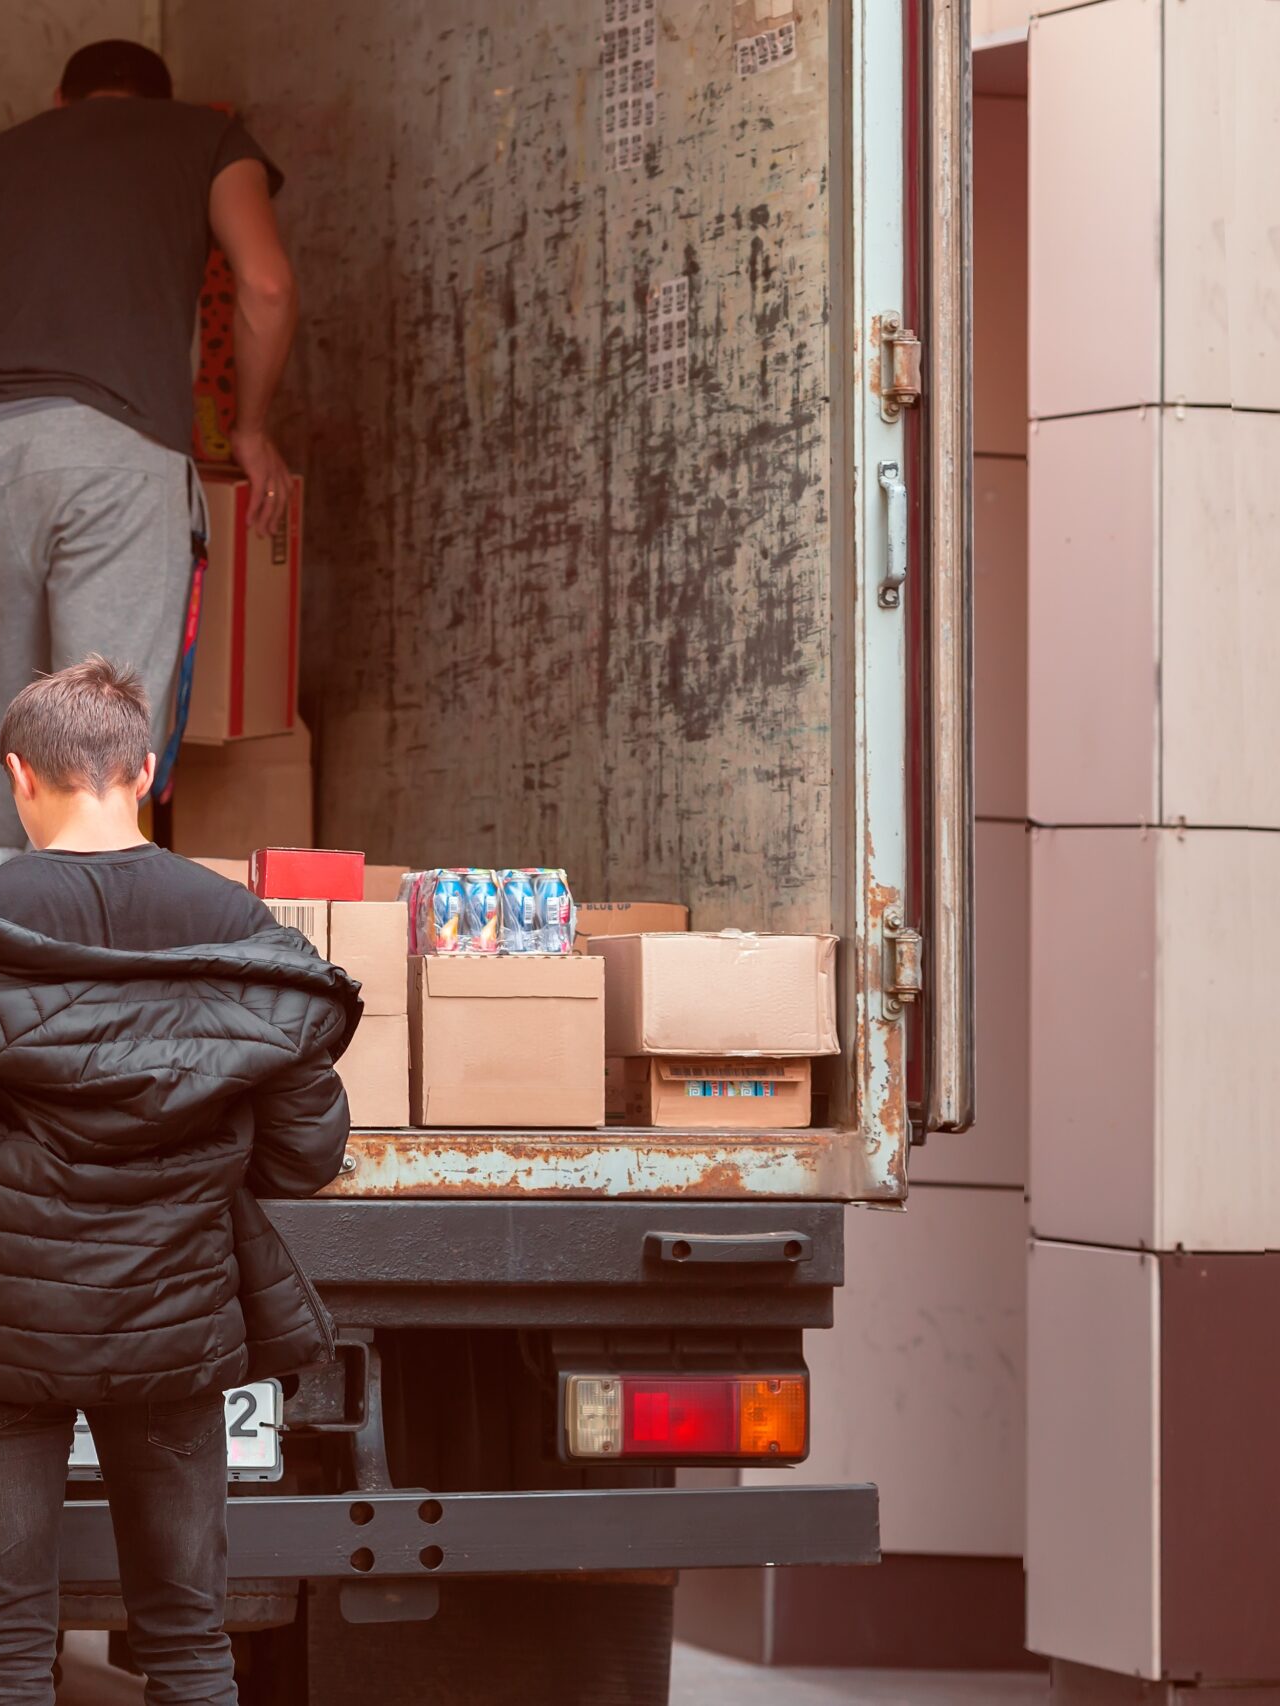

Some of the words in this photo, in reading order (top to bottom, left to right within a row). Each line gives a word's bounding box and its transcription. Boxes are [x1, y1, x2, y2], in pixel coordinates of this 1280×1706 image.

[586, 902, 613, 911] BLUE
[617, 902, 632, 911] UP
[228, 1389, 258, 1438] 2
